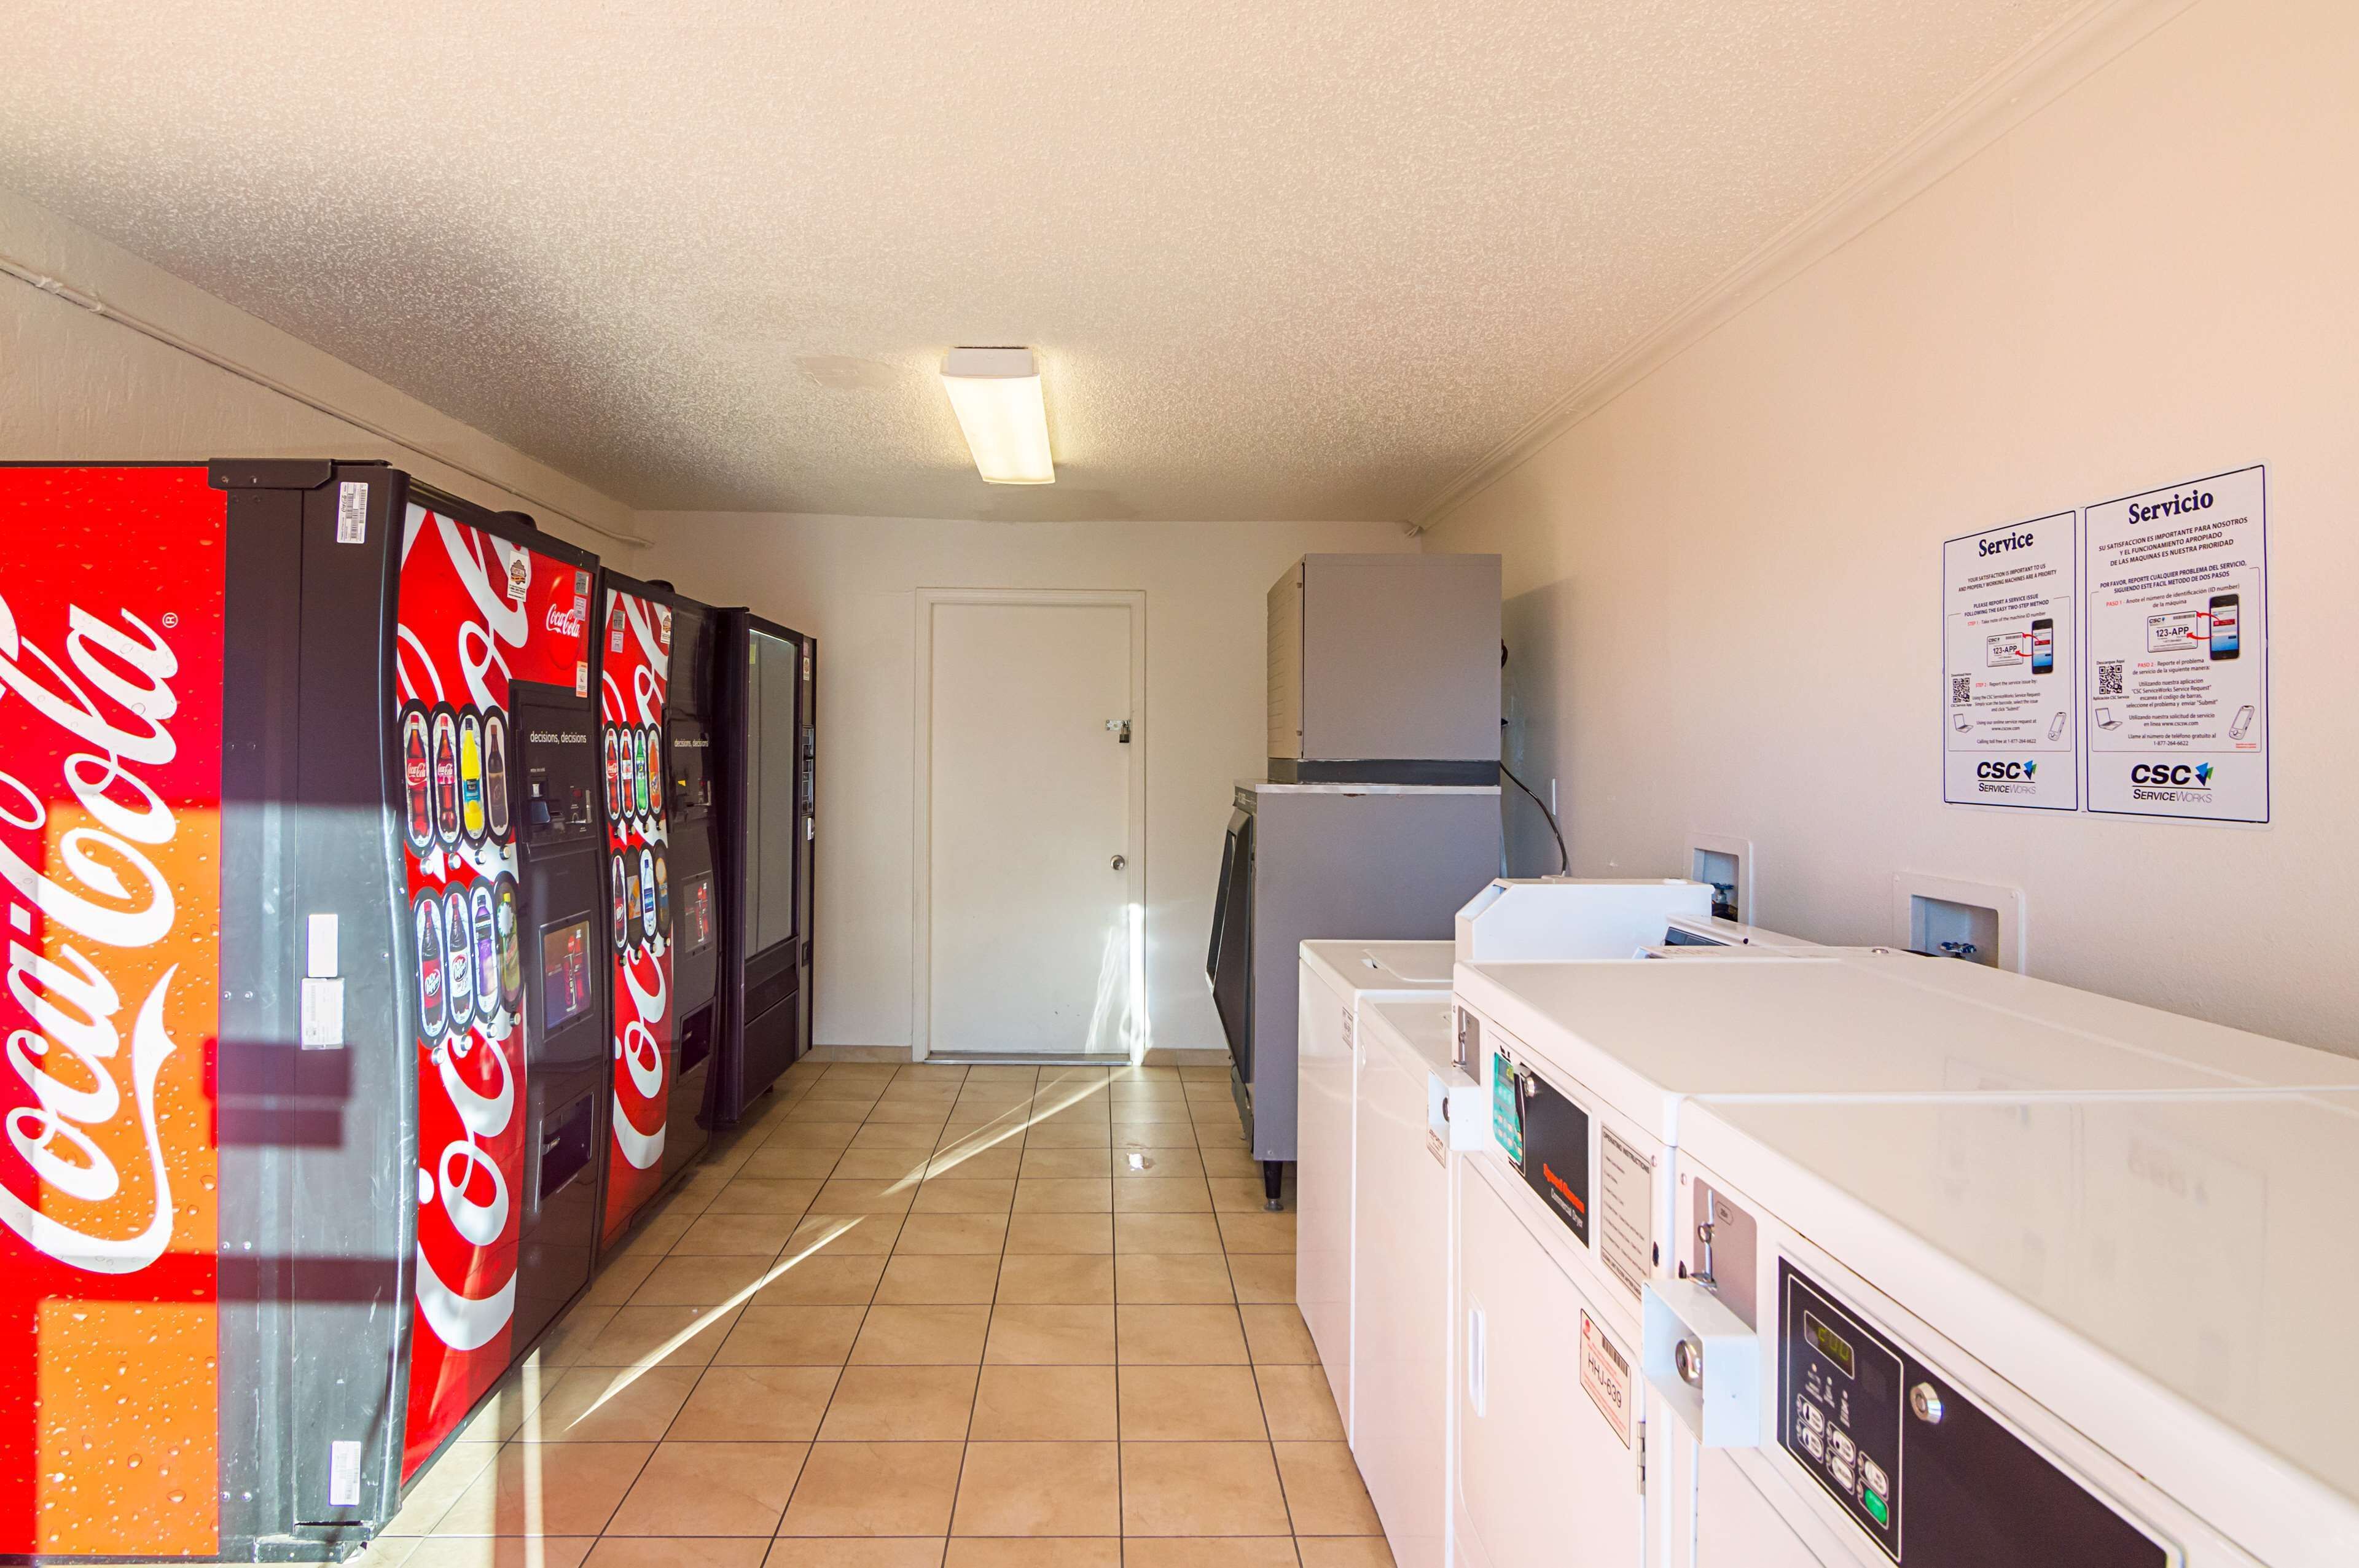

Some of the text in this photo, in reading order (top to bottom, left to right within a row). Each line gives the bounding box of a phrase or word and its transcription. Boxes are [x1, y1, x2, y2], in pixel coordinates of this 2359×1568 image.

[2129, 490, 2213, 525] Servicio
[2107, 537, 2146, 550] SATISFACCION
[2154, 528, 2193, 541] IMPORTANTE
[2194, 524, 2210, 533] PARA
[2212, 517, 2248, 530] NOSOTROS
[2132, 539, 2184, 553] FUNCIONAMIENTO
[2185, 531, 2222, 544] APROPIADO
[1979, 532, 2033, 557] Service
[2130, 552, 2161, 563] MAQUINAS
[2170, 545, 2197, 556] NUESTRA
[2199, 539, 2233, 551] PRIORIDAD
[1979, 571, 2005, 581] SATISFACTION
[2010, 566, 2033, 575] IMPORTANT
[2128, 575, 2149, 584] REPORTE
[2150, 571, 2178, 580] CUALQUIER
[2180, 566, 2207, 576] PROBLEMA
[2220, 560, 2247, 570] SERVICIO,
[2114, 585, 2140, 593] SIGUIENDO
[2168, 577, 2190, 586] METODO
[2173, 588, 2207, 598] identificación
[2217, 583, 2240, 593] number)
[546, 604, 580, 638] Coca-Cola
[2156, 626, 2189, 638] 123-APP
[1993, 646, 2017, 654] 123-APP
[530, 731, 587, 744] decisions, decisions
[1977, 762, 2021, 779] CSC
[2132, 764, 2191, 785] CSC
[1573, 1209, 1582, 1228] Dryer
[1588, 1352, 1622, 1408] HHJ-639
